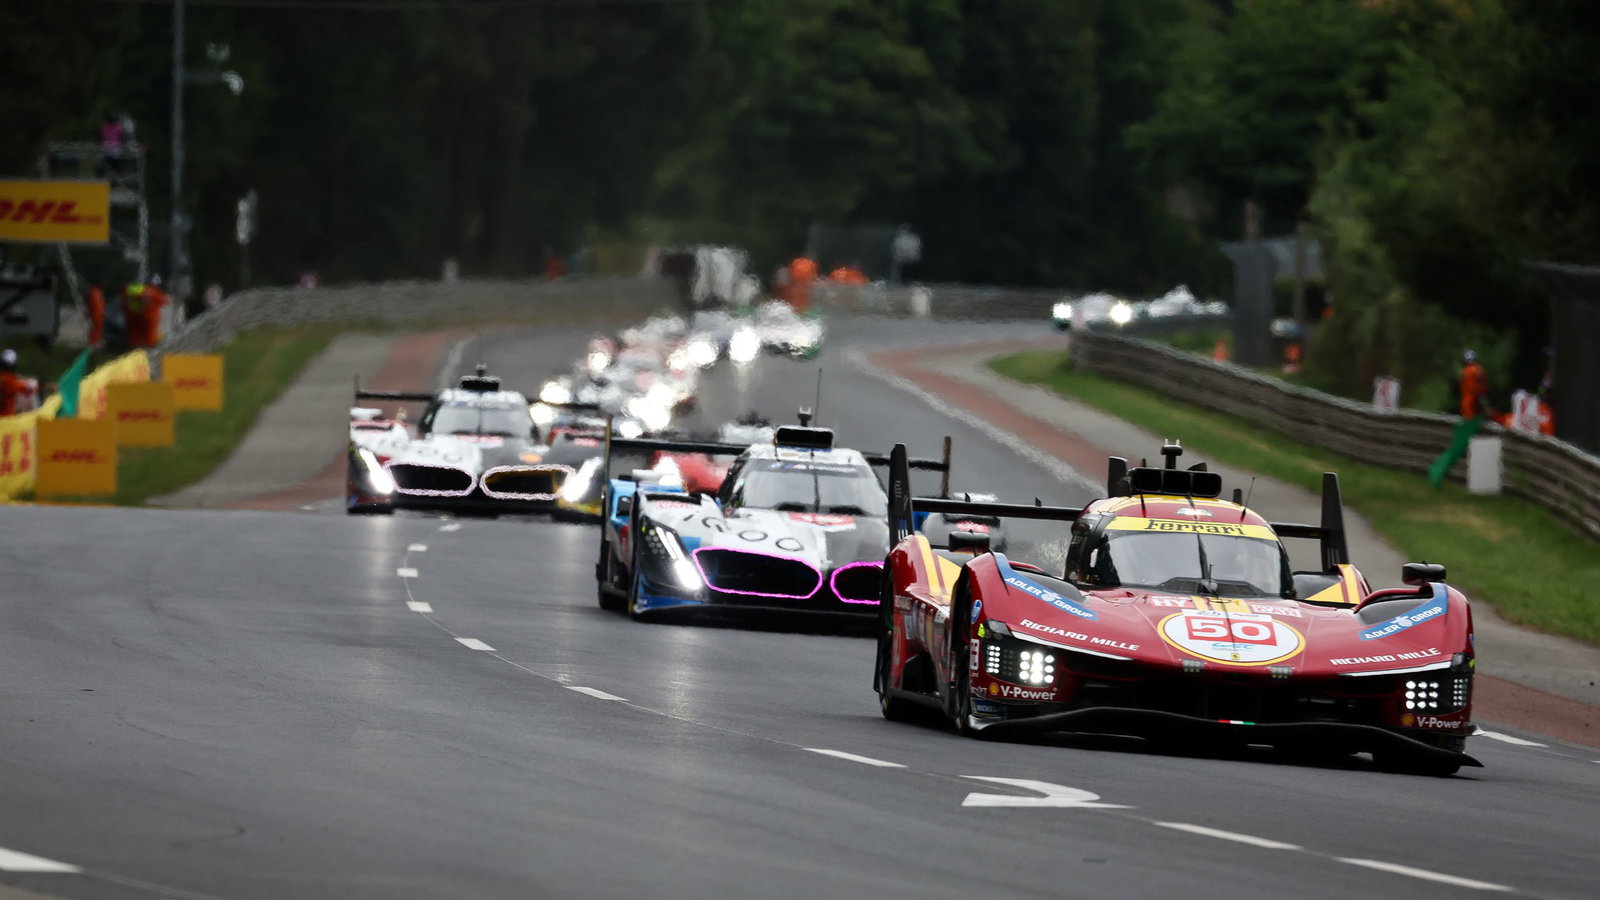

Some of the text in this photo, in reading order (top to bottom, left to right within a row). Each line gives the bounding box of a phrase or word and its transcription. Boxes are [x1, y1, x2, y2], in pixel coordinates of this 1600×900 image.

[1144, 519, 1246, 535] Ferrari
[1005, 577, 1093, 618] ADLER GROUP
[1191, 619, 1272, 641] 50
[1364, 606, 1443, 639] ADLER GROUP
[1020, 619, 1140, 651] RICHARD MILLE
[1329, 647, 1441, 665] RICHARD MILLE
[1000, 685, 1056, 700] V-Power
[1416, 716, 1461, 729] V-Power
